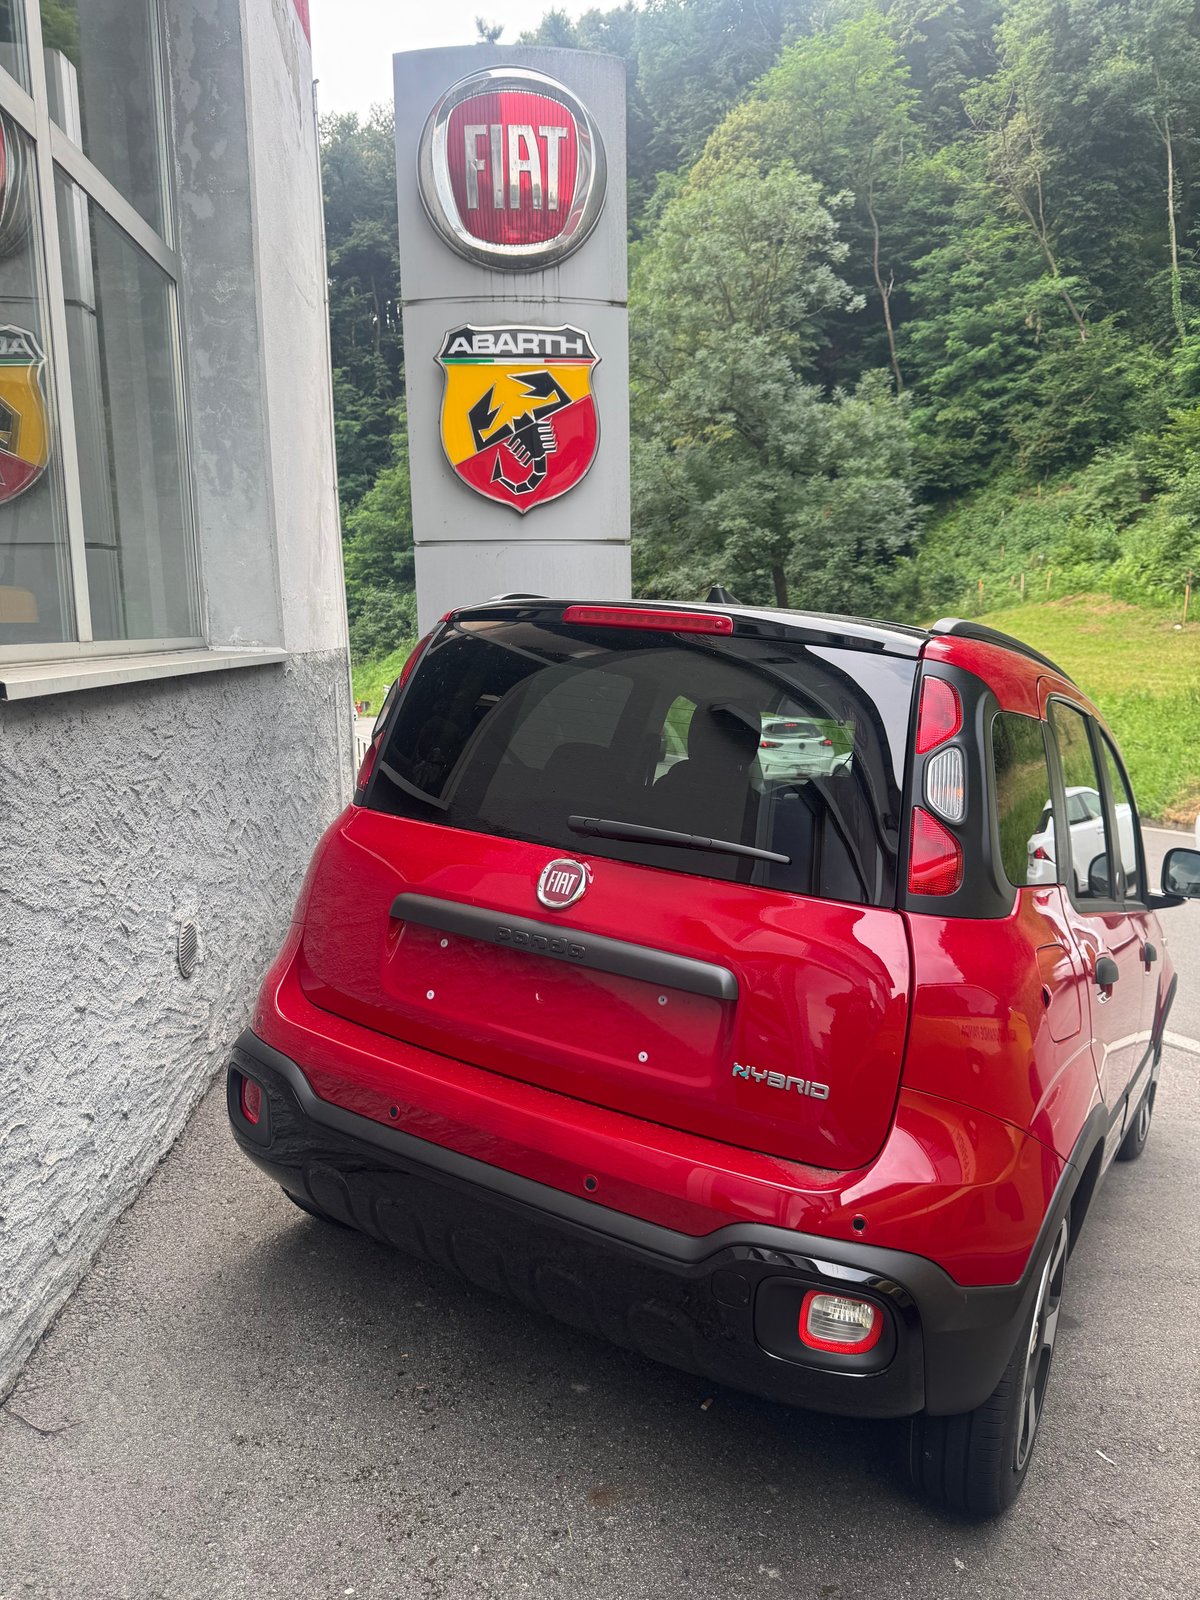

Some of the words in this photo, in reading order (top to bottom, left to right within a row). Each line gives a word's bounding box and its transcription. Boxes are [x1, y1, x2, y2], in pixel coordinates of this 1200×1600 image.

[463, 124, 568, 211] FIAT
[448, 333, 582, 355] ABARTH
[545, 870, 579, 896] FIAT
[731, 1061, 830, 1101] HYBRID
